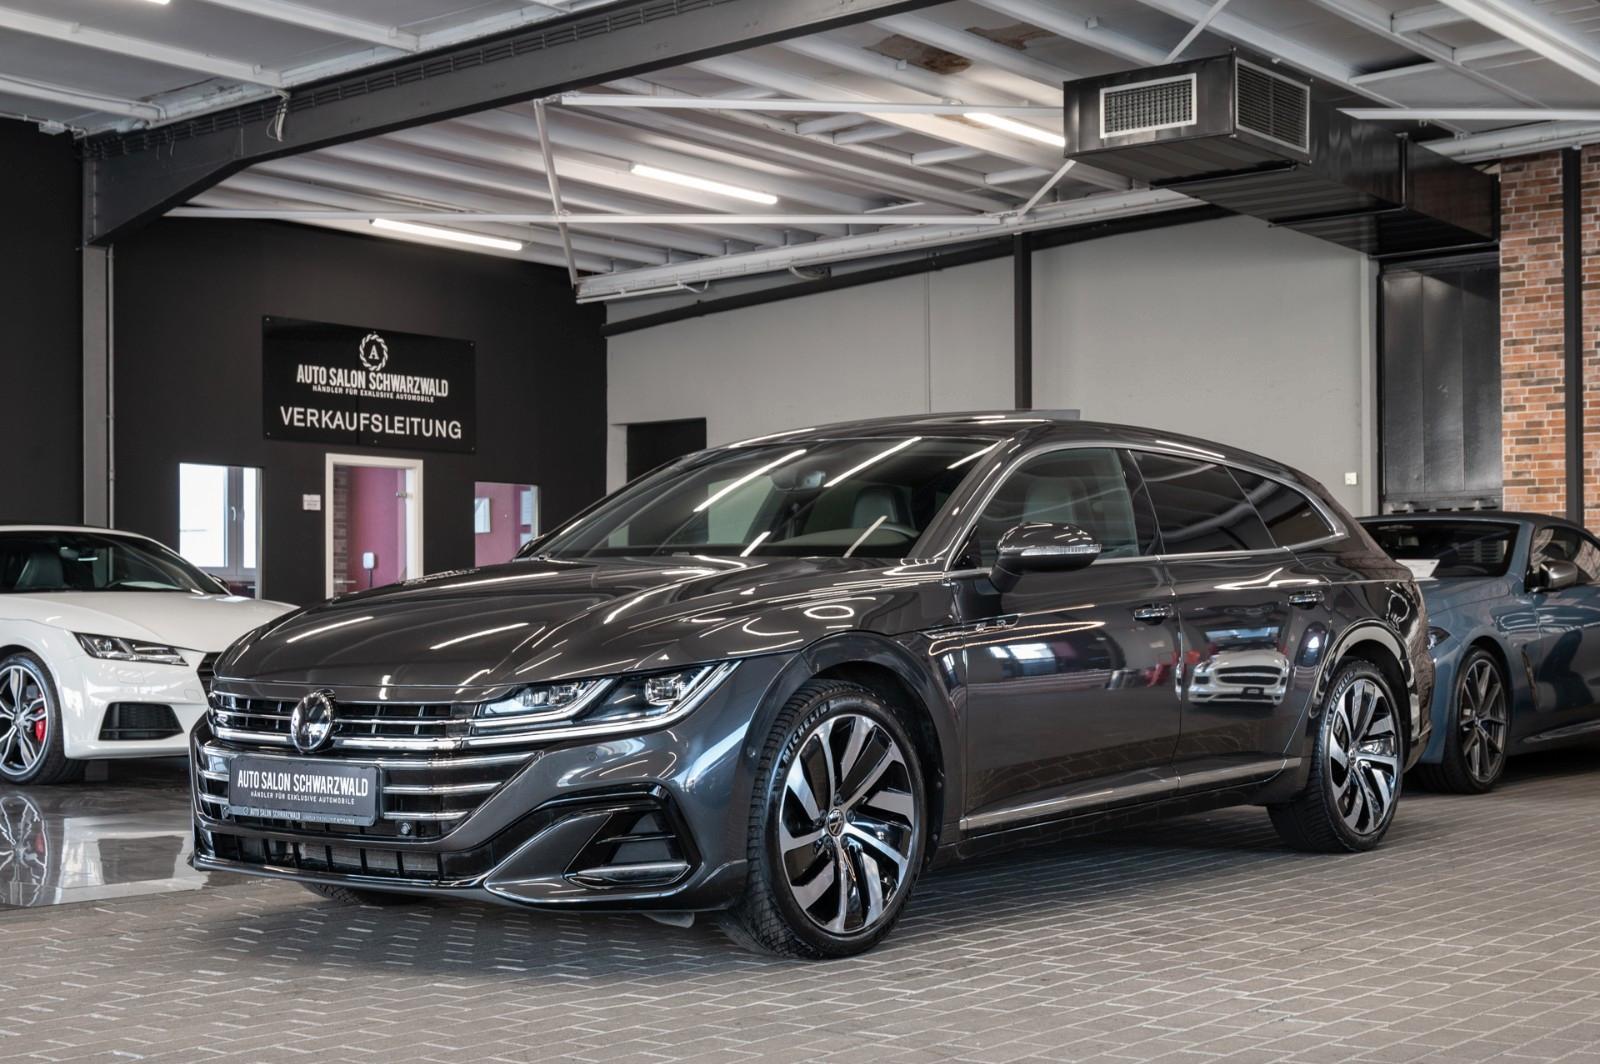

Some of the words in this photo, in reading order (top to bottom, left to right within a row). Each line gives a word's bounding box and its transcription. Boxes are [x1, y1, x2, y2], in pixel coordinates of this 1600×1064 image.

[369, 345, 379, 360] A
[296, 364, 327, 385] AUTO
[329, 368, 366, 389] SALON
[369, 372, 449, 398] SCHWARZWALD
[280, 406, 462, 439] VERKAUFSLEITUNG
[782, 703, 829, 764] MICHELIN
[238, 770, 260, 788] AUTO
[261, 772, 291, 790] SALON
[293, 774, 368, 797] SCHWARZWALD
